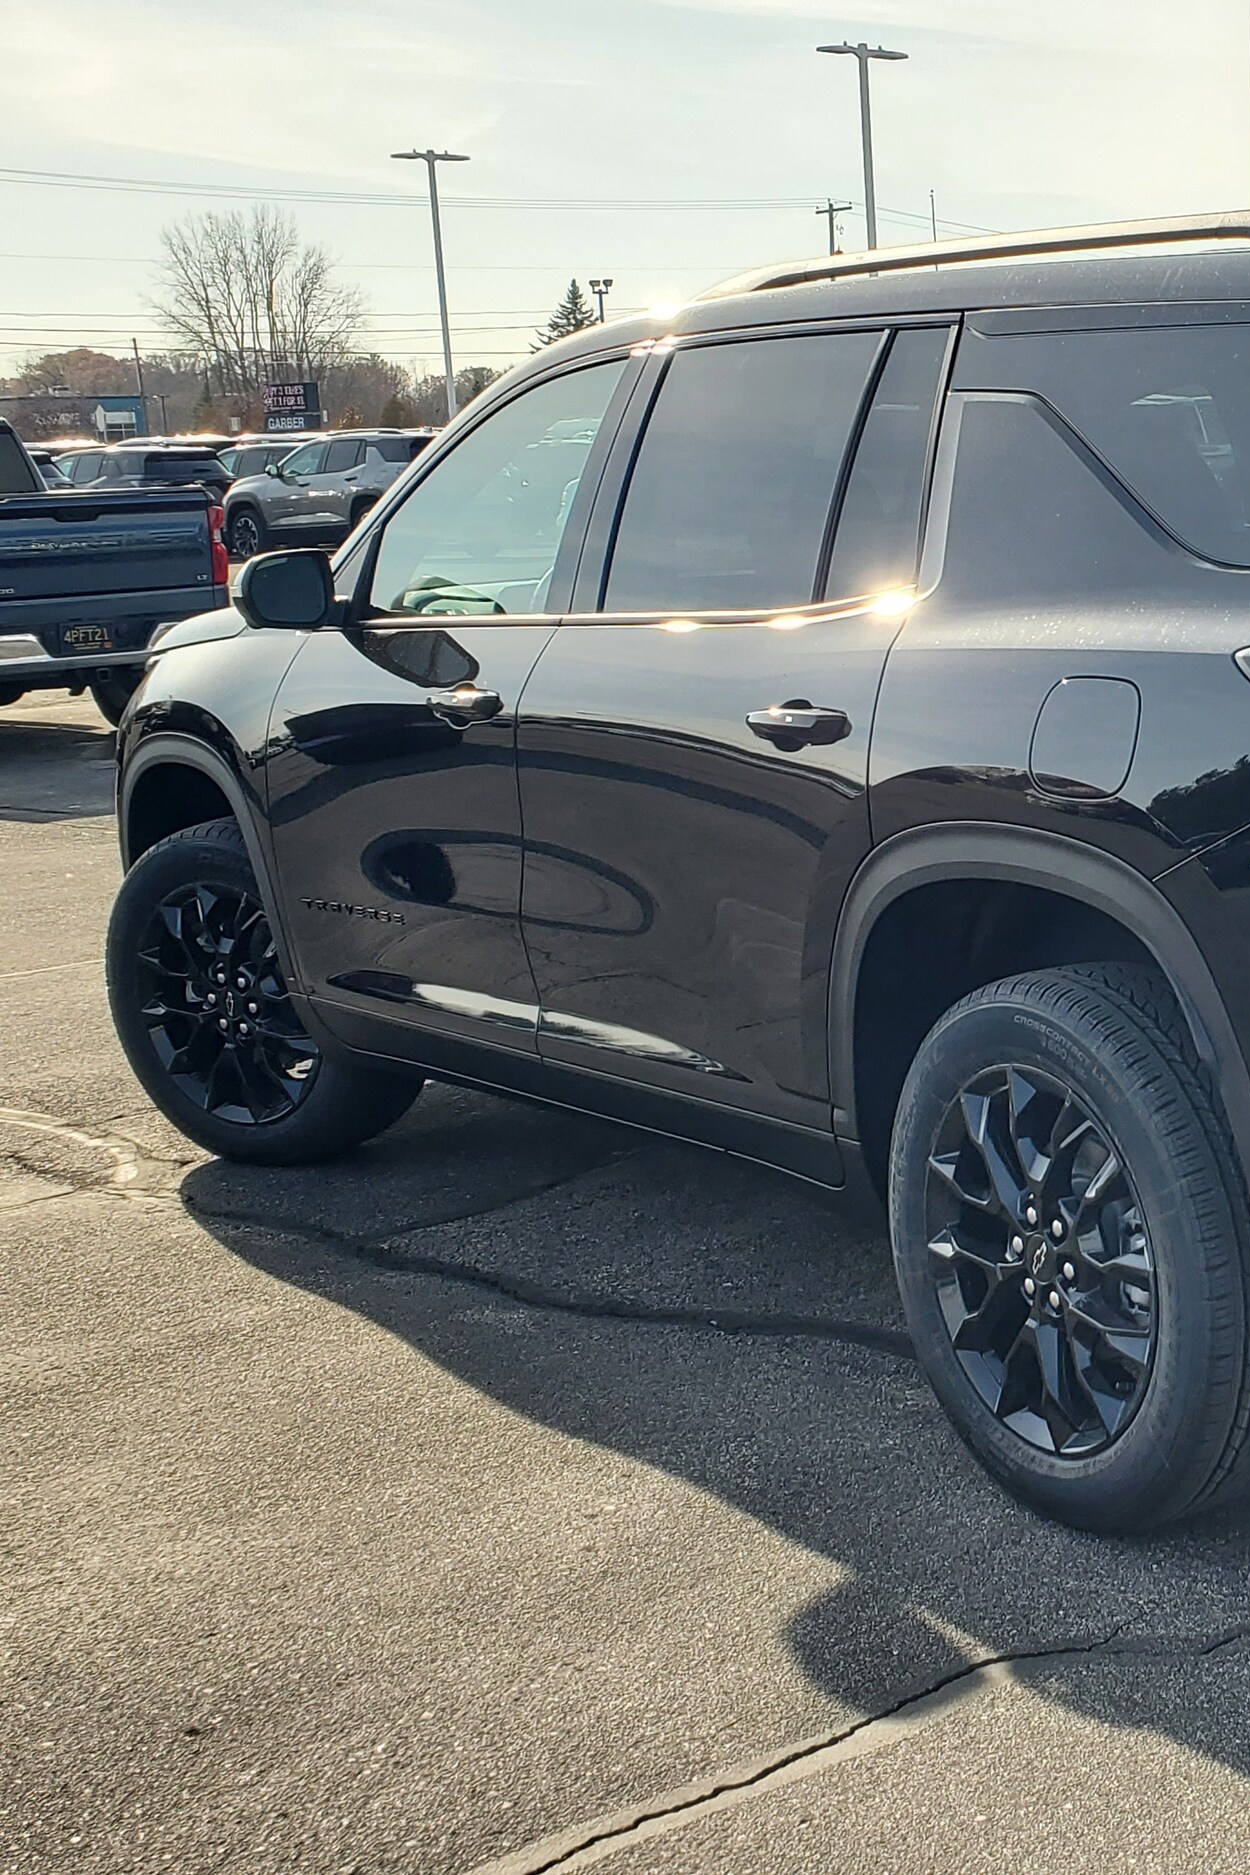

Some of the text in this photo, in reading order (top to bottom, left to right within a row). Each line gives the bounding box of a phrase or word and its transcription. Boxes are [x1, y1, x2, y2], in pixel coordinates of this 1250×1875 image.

[268, 416, 305, 430] GARBER
[64, 627, 109, 643] 4PFT21
[300, 897, 406, 926] TRAVERSE
